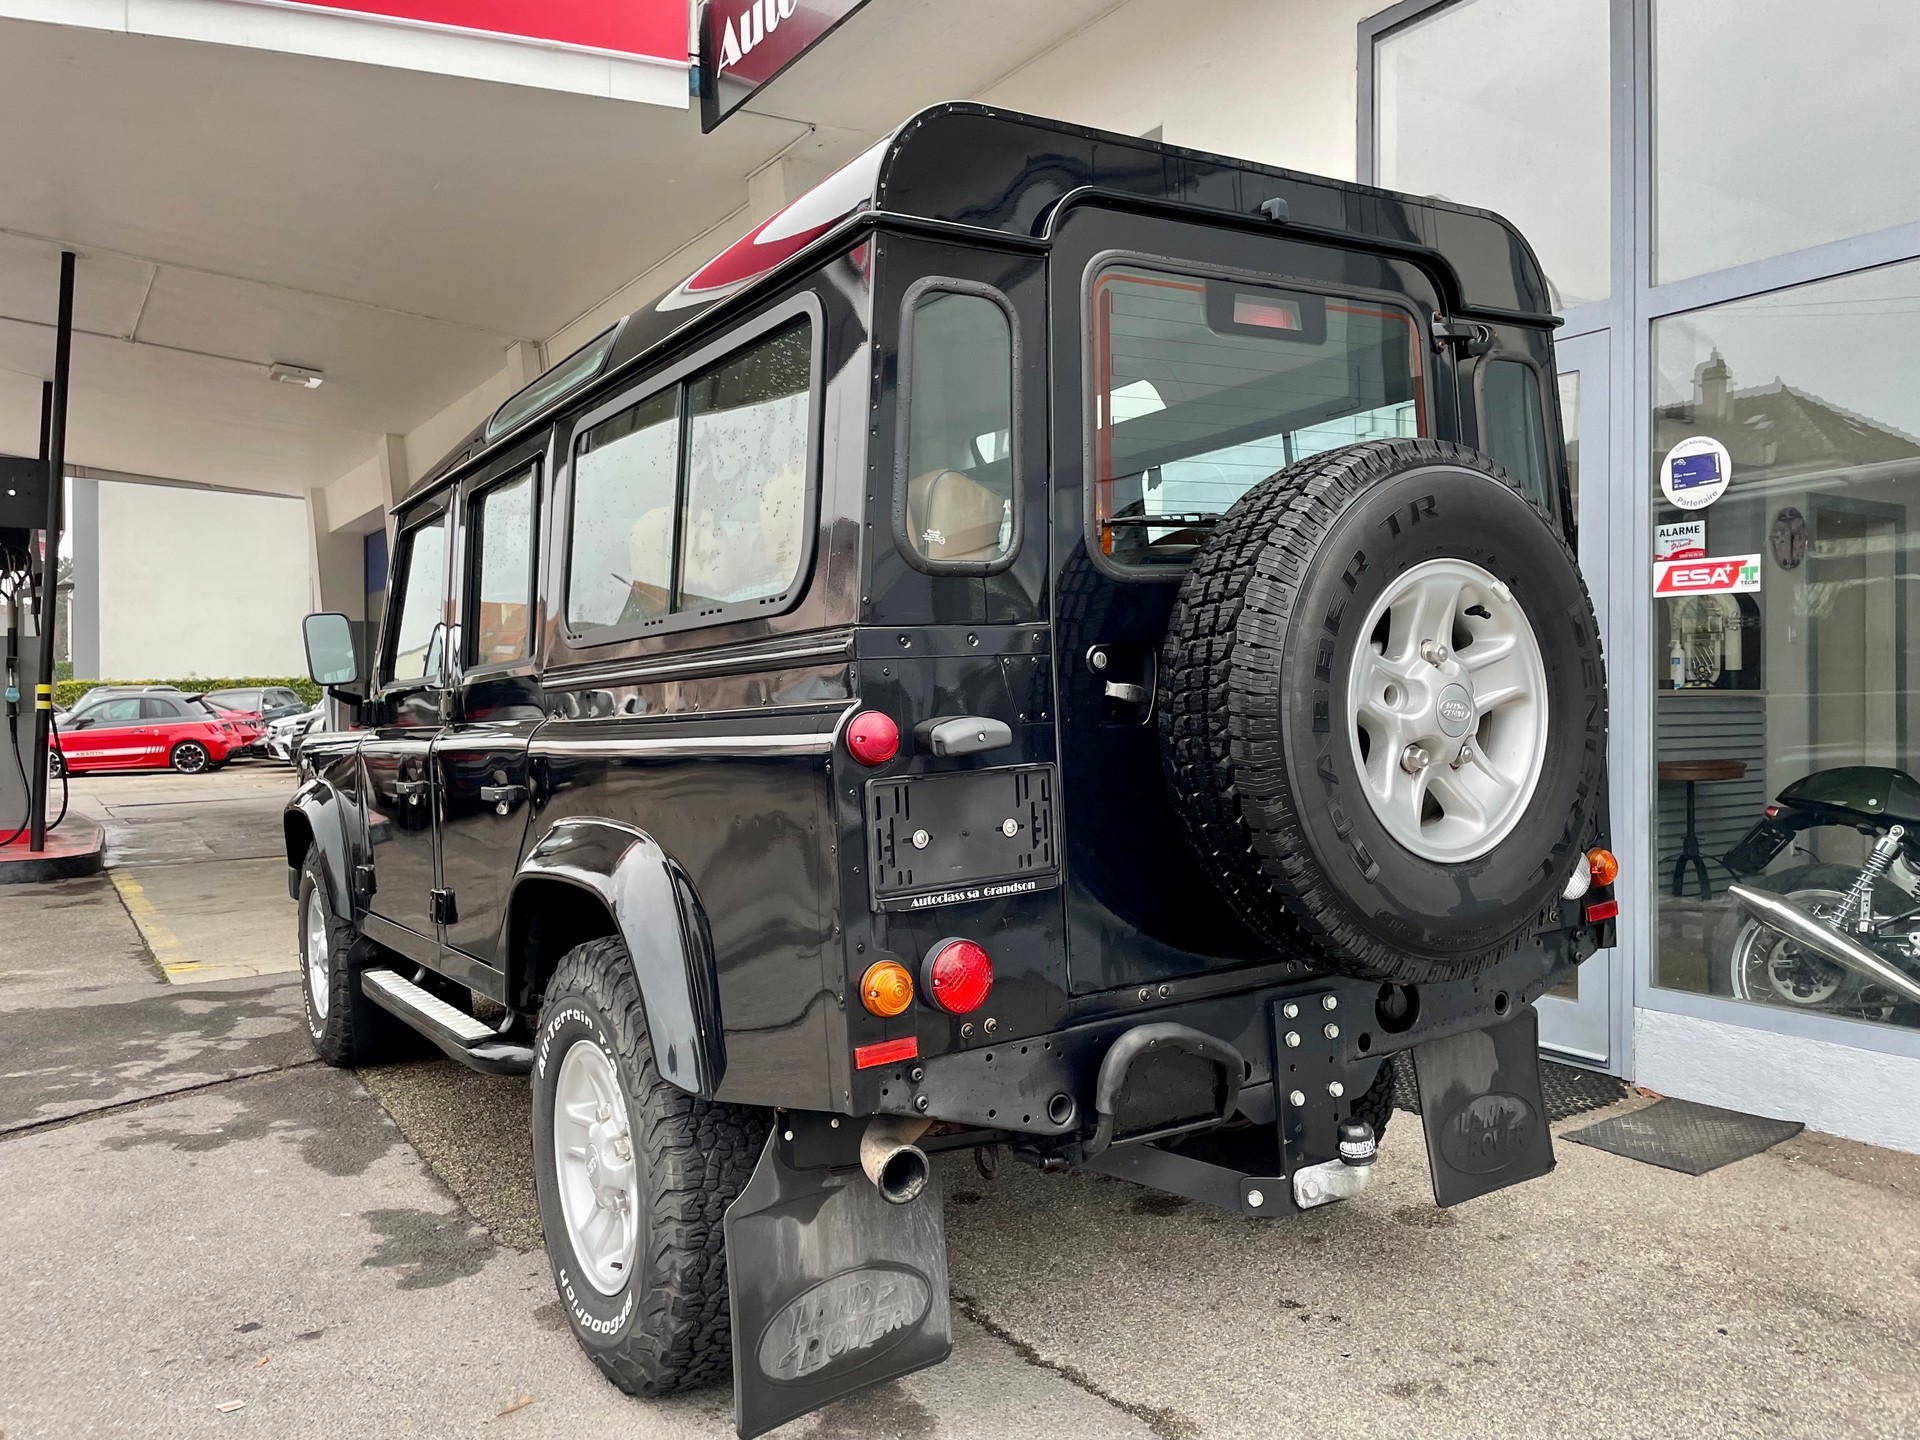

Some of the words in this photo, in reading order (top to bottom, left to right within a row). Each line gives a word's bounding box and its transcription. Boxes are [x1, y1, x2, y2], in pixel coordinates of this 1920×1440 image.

[1676, 490, 1718, 507] Partenaire
[1659, 525, 1700, 538] ALARME
[1312, 548, 1381, 884] GRABBER
[1376, 493, 1439, 540] TR
[910, 890, 965, 908] Autoclass
[966, 889, 980, 899] sa
[983, 880, 1036, 897] Grandson
[560, 1268, 633, 1336] BFGoodrich
